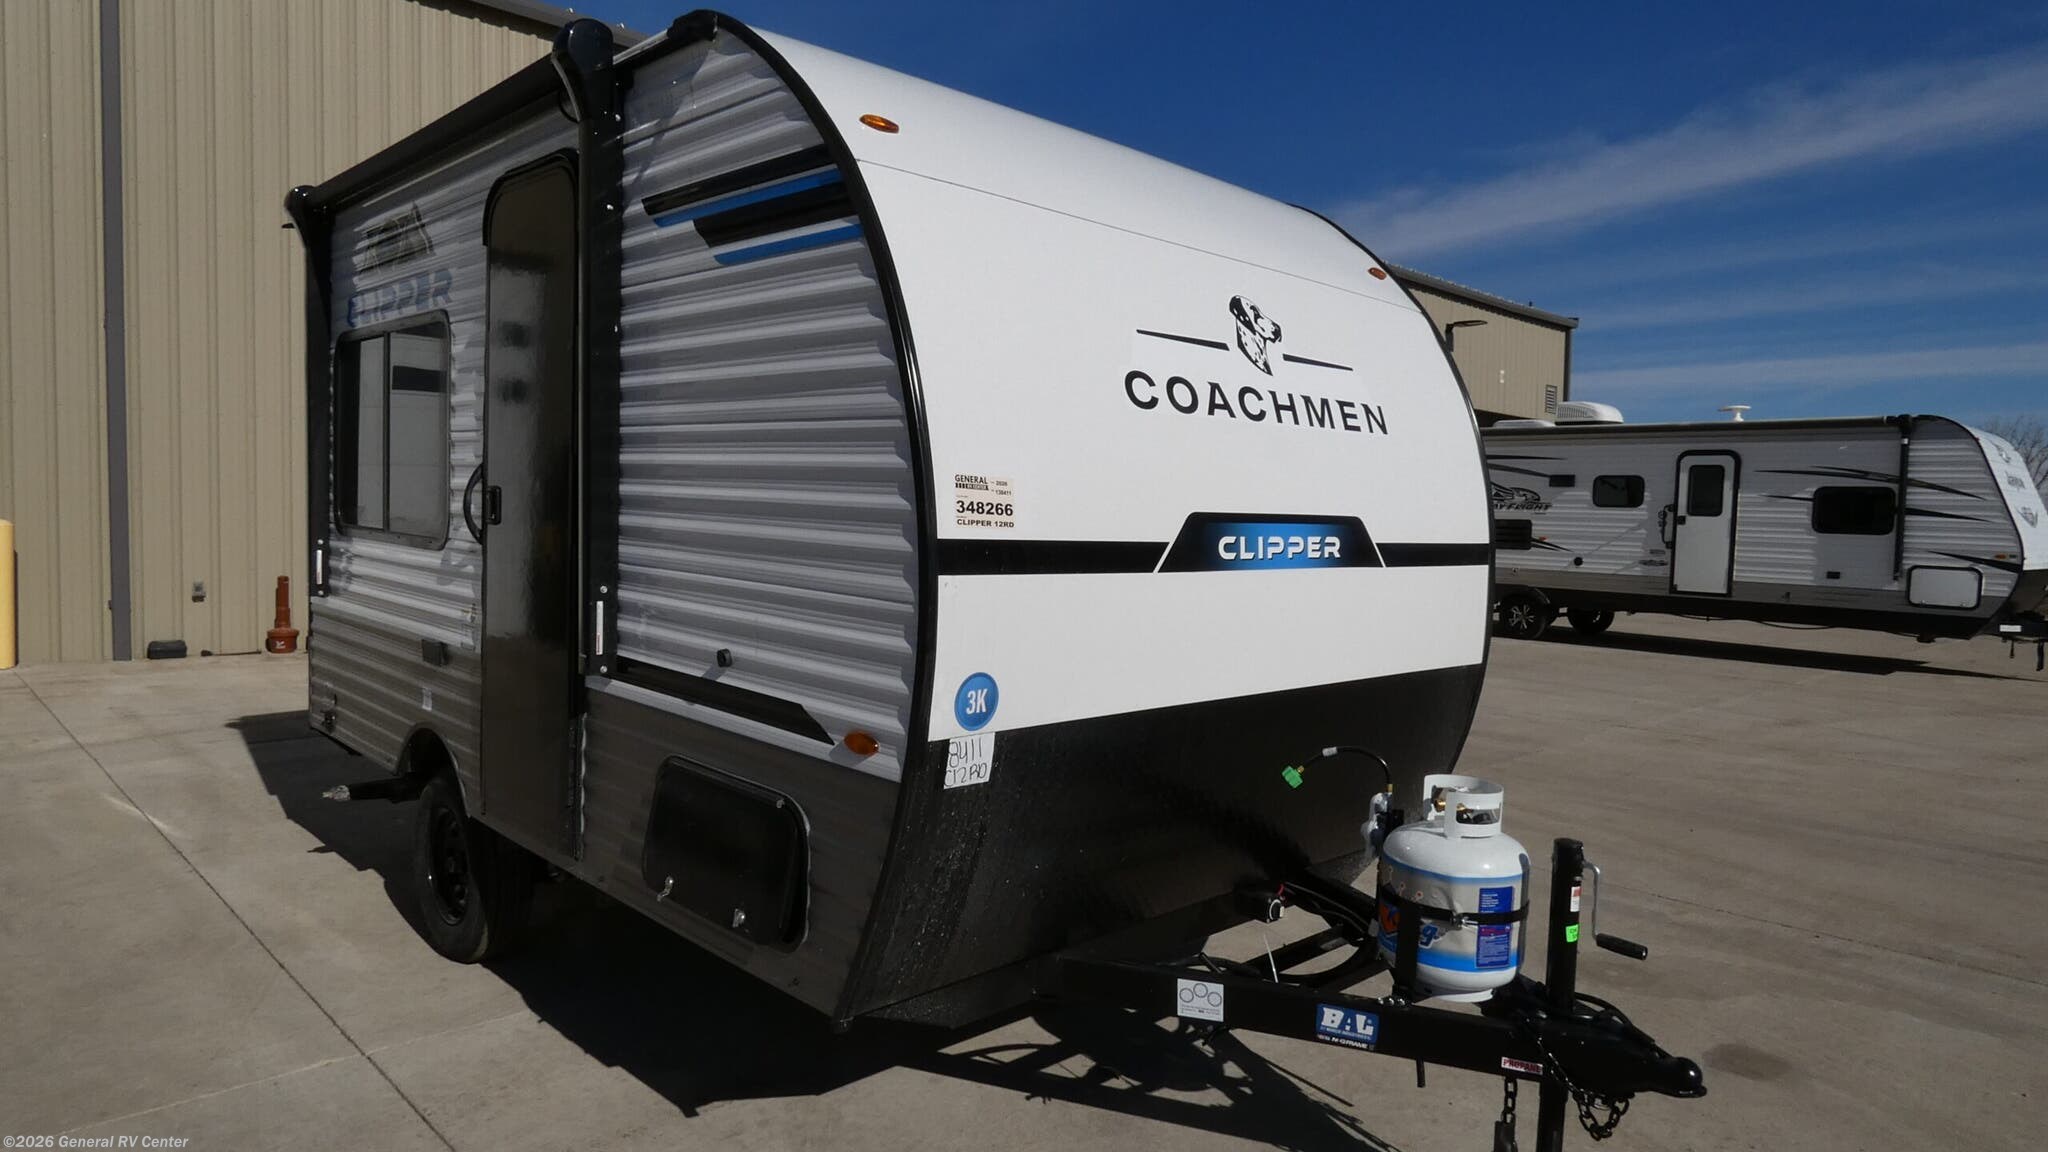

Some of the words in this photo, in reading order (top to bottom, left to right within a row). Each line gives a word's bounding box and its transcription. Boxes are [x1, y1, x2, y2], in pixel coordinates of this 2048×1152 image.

[347, 269, 452, 326] CLIPPER
[1124, 369, 1389, 435] COACHMEN
[955, 474, 987, 484] GENERAL
[956, 500, 1013, 516] 348266
[956, 518, 992, 527] CLIPPER
[994, 520, 1015, 528] 12RD
[1218, 535, 1342, 560] CLIPPER
[966, 689, 987, 714] 3K
[949, 738, 982, 768] 8411
[1321, 1007, 1374, 1036] BAL
